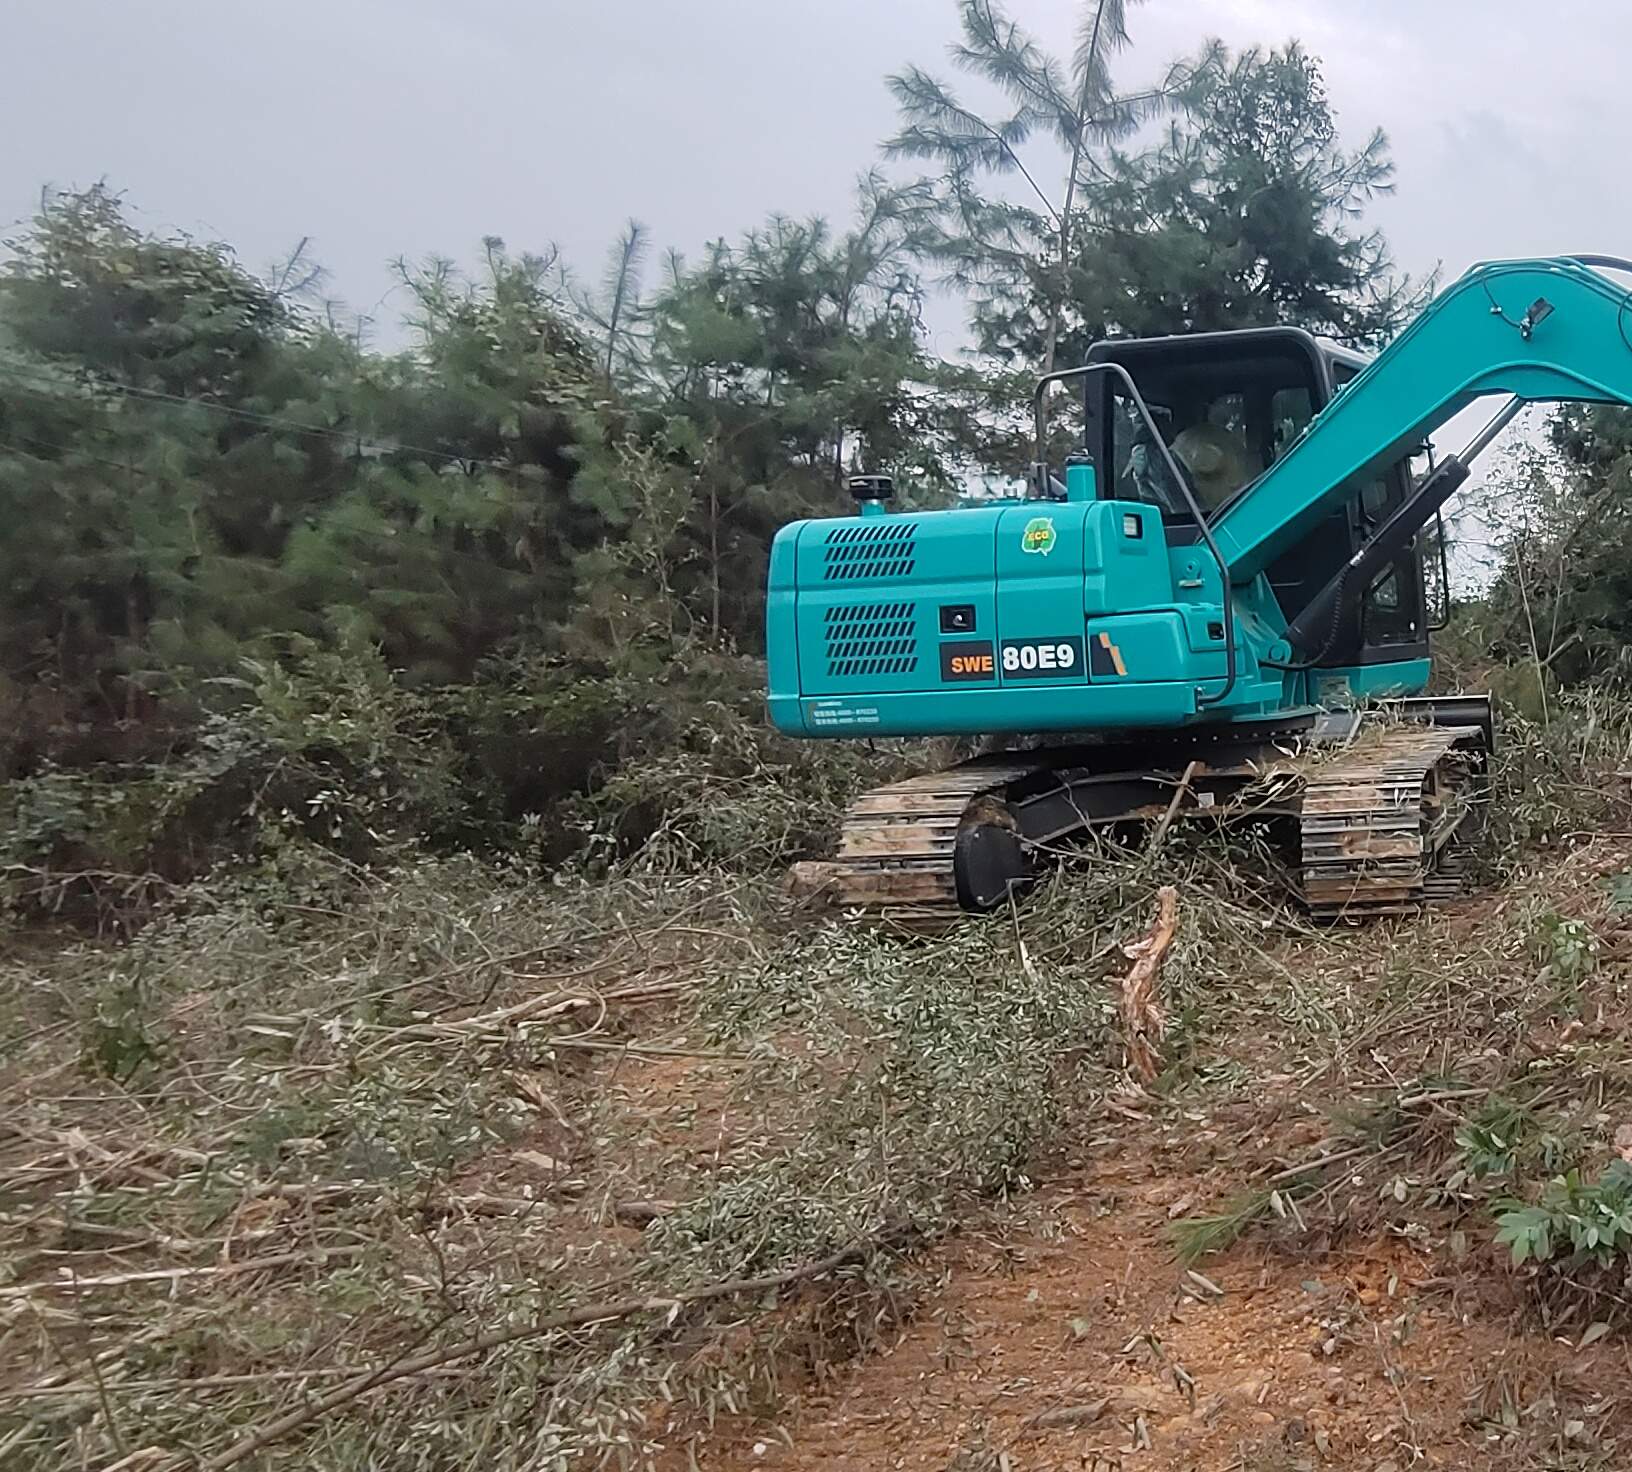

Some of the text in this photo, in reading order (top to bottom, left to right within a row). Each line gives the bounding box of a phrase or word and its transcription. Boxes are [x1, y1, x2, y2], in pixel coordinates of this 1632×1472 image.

[1028, 530, 1049, 541] ECO
[951, 643, 1075, 673] SWE 80E9
